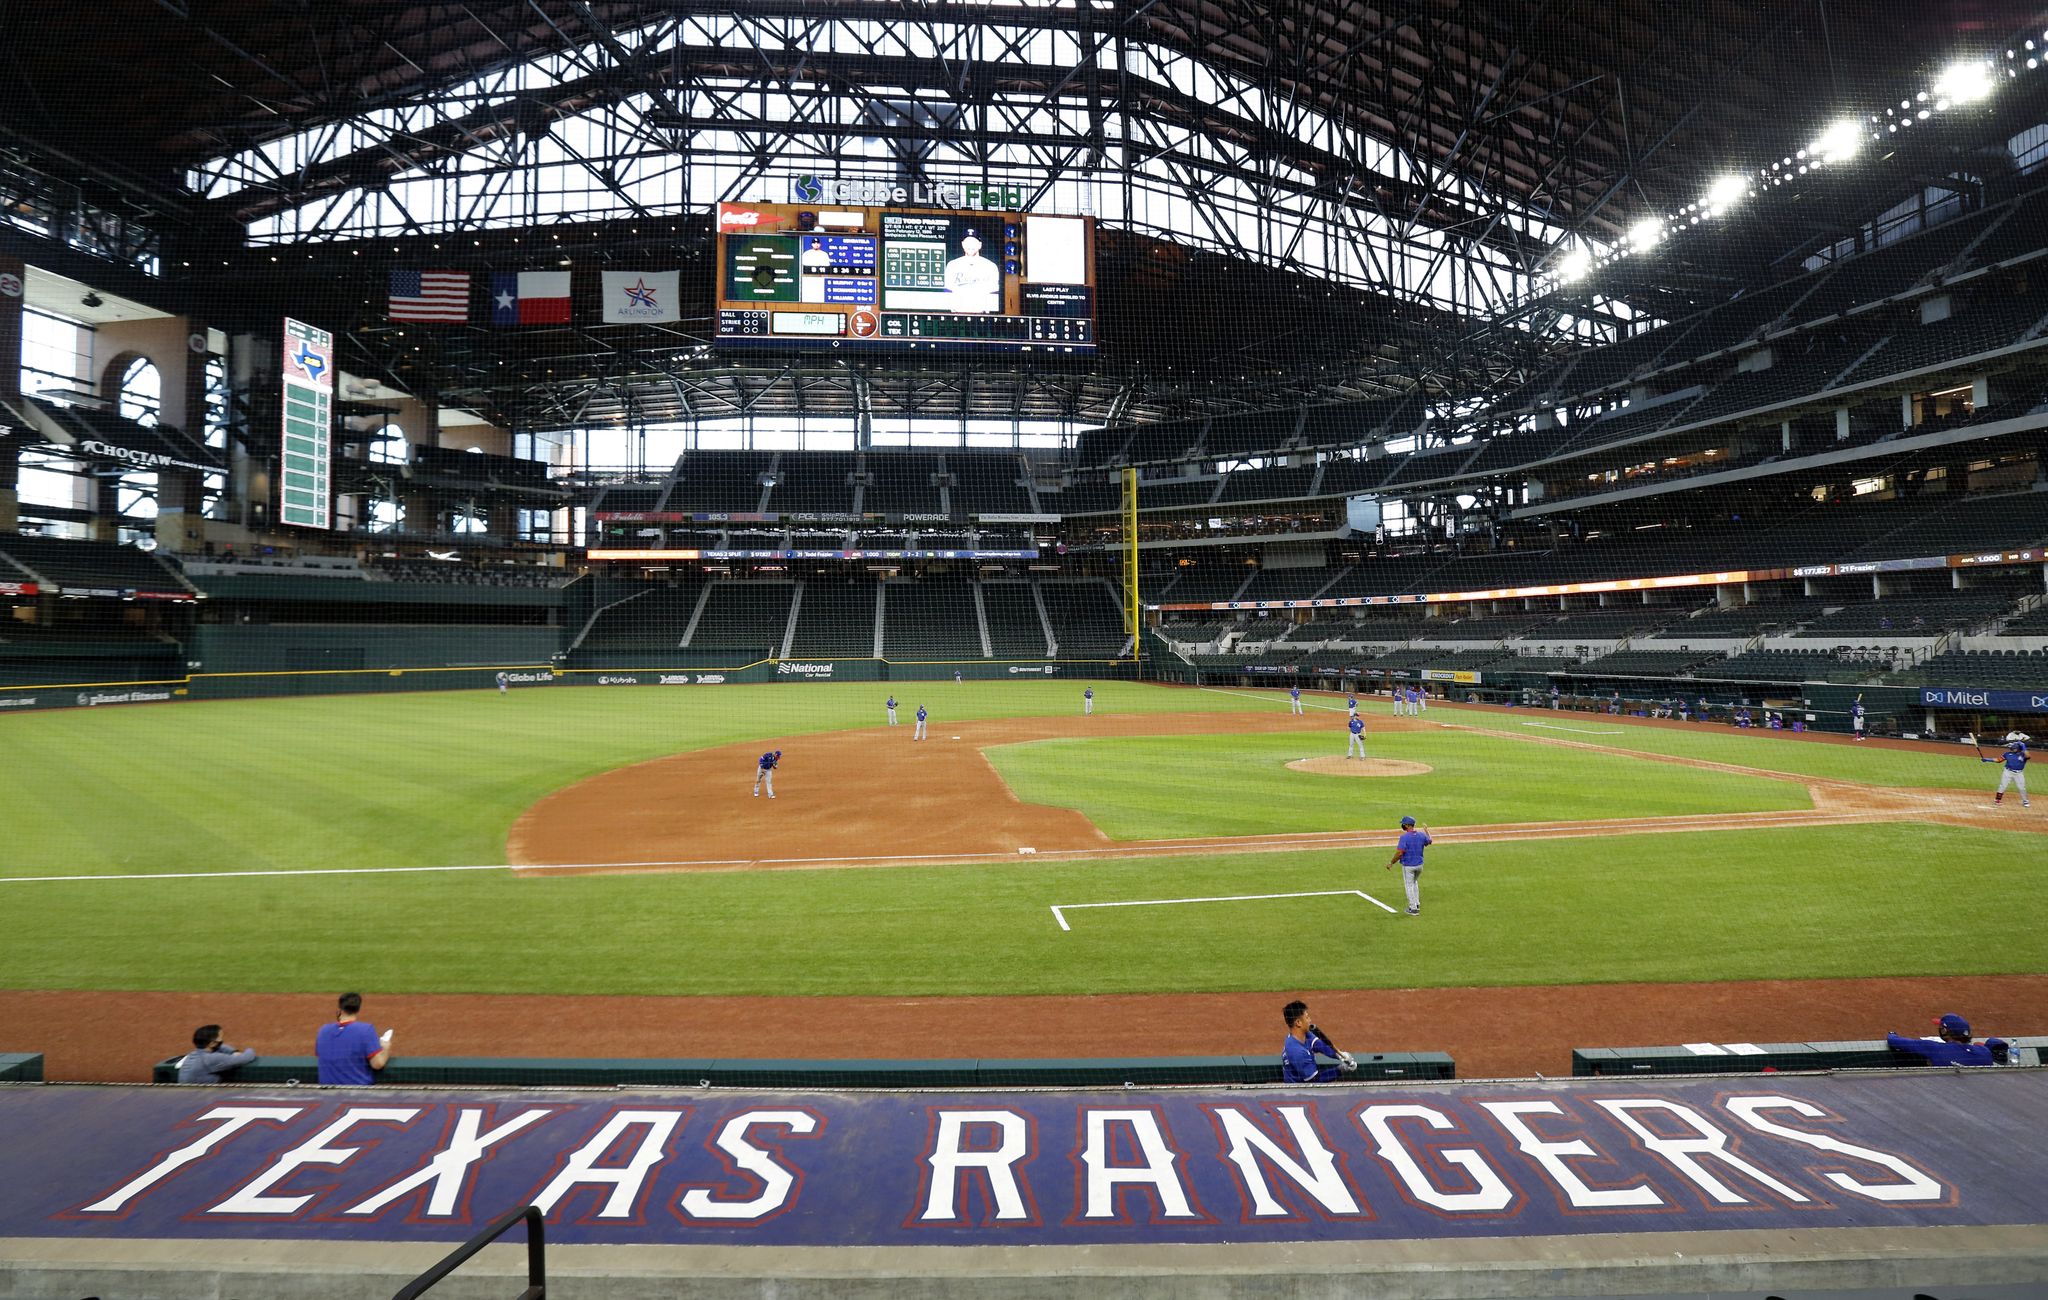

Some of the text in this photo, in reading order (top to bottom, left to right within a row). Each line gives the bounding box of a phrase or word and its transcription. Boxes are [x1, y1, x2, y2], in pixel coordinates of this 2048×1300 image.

[831, 180, 1021, 207] Globe Life Field
[618, 308, 664, 316] ARLINGTON
[803, 315, 824, 325] MPH
[90, 441, 172, 466] CHOCTAW
[1804, 567, 1831, 576] 177,827
[791, 663, 832, 672] National
[508, 672, 553, 682] Globe Life
[90, 693, 129, 705] planet
[130, 692, 170, 701] fitness
[1947, 692, 1988, 705] Mitel
[78, 1106, 816, 1219] TEXAS
[919, 1096, 1942, 1220] RANGERS
